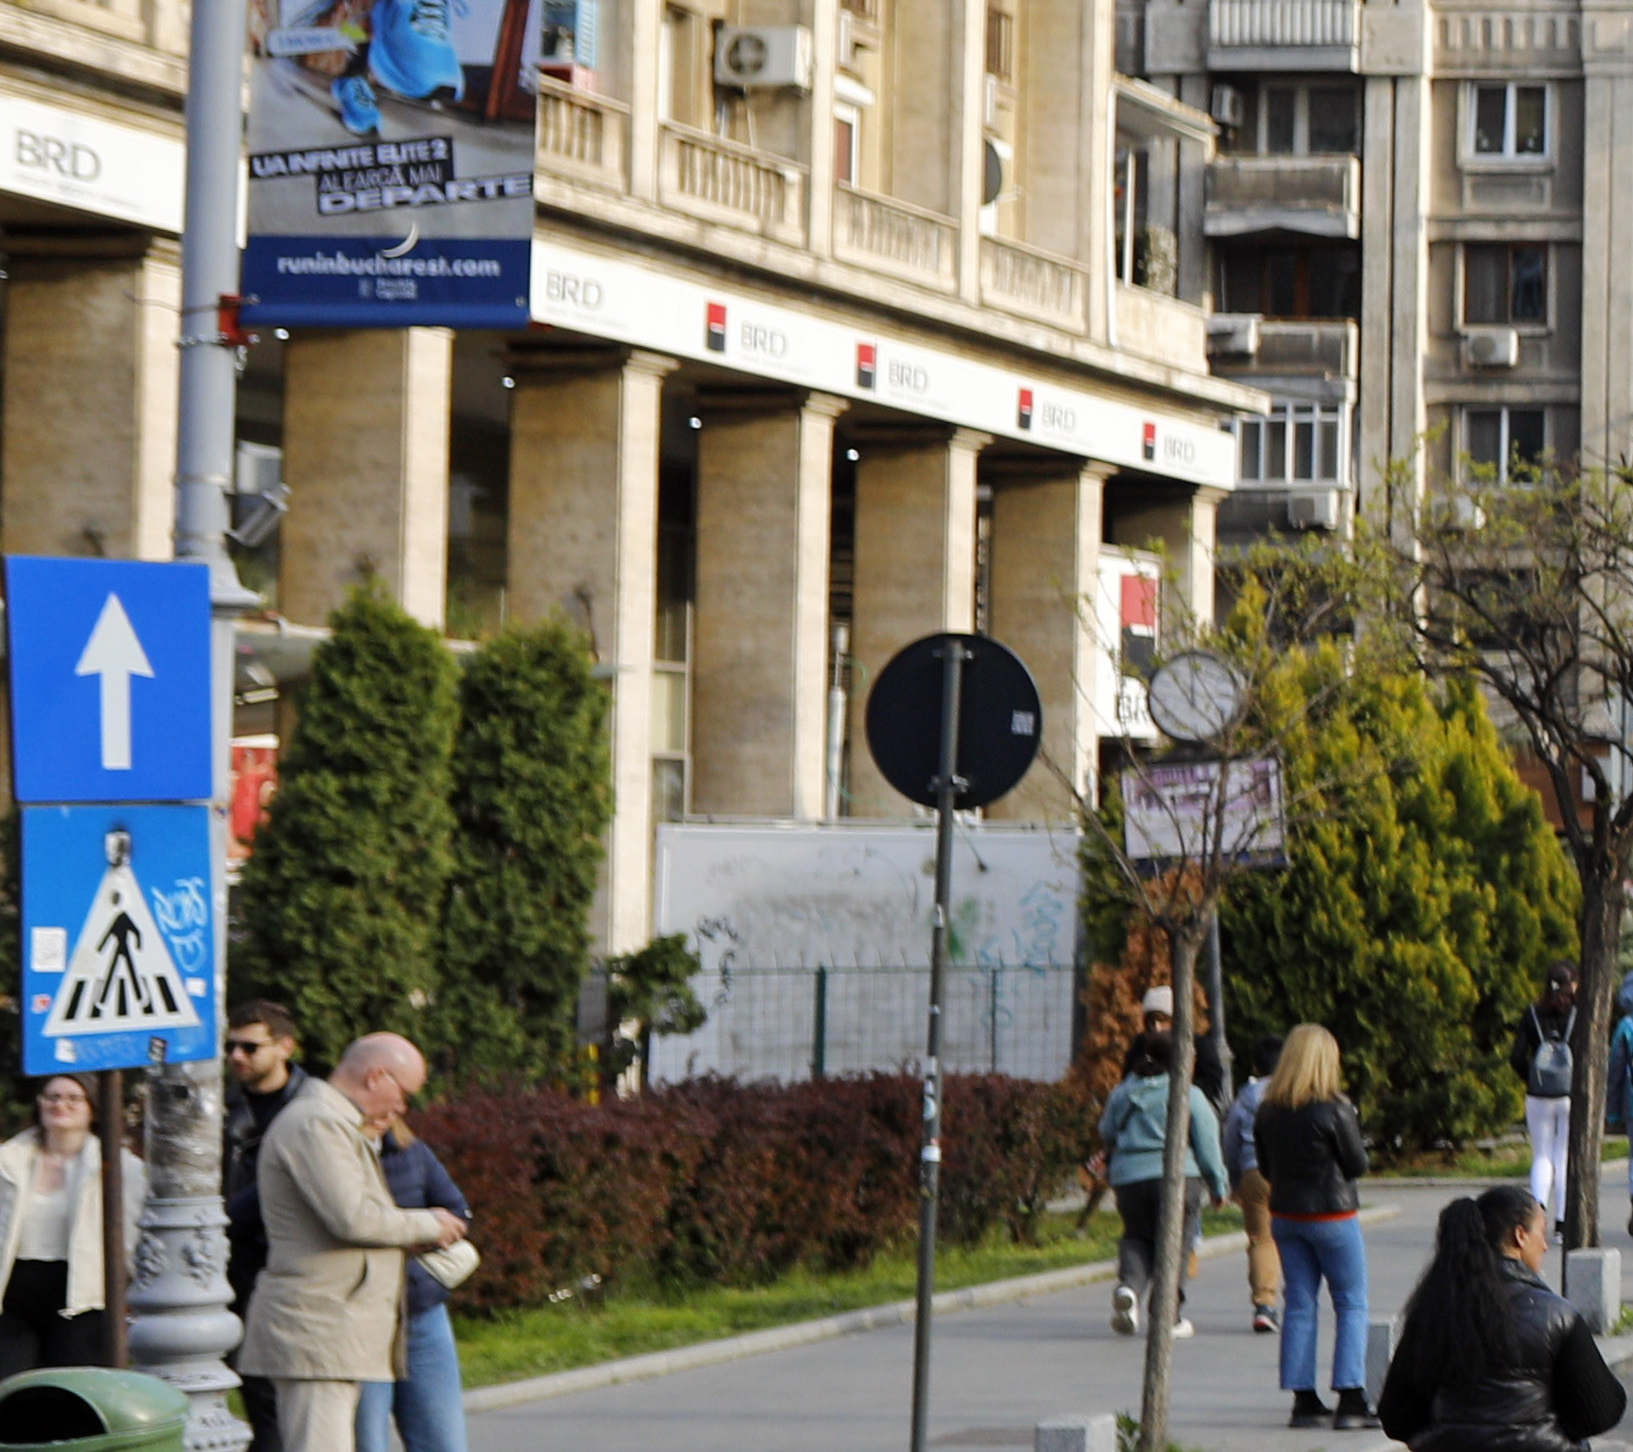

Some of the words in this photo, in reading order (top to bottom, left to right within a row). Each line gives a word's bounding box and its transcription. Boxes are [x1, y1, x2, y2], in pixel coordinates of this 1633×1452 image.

[15, 129, 102, 182] BRD
[253, 156, 286, 176] UA
[289, 148, 374, 173] INFINITE
[377, 141, 428, 166] ELITE
[431, 139, 447, 160] 2
[410, 163, 443, 184] MAI
[319, 176, 531, 214] DEPARTE
[277, 251, 501, 277] runinbucharest.com
[546, 269, 604, 311] BRD
[741, 320, 787, 357] BRD
[888, 360, 929, 392] BRD
[1041, 401, 1076, 432] BRD
[1164, 434, 1195, 460] BRD
